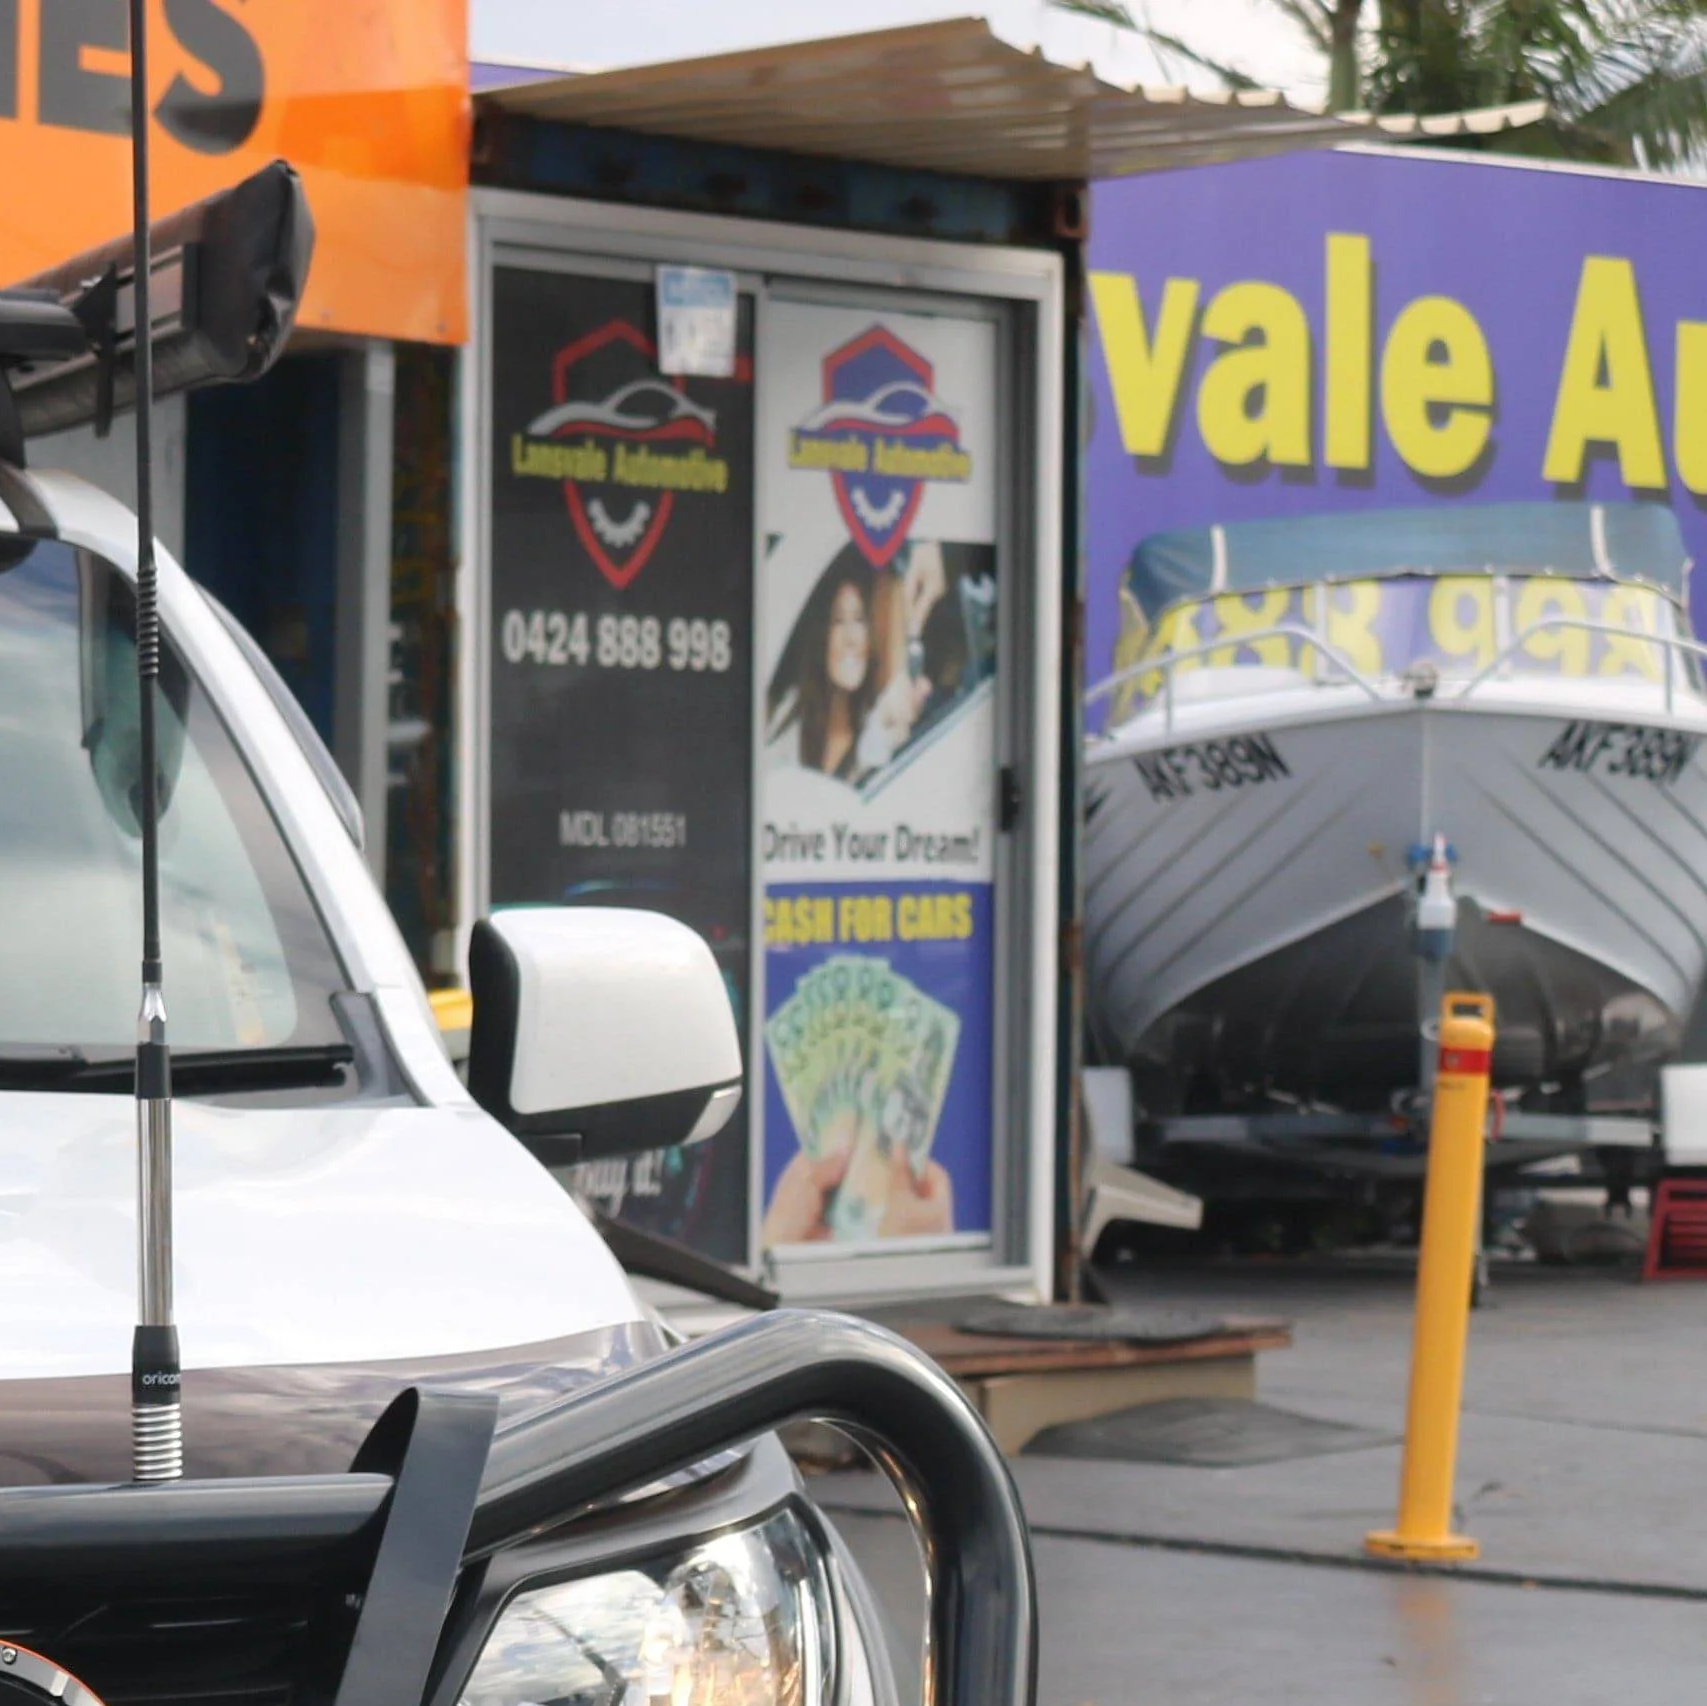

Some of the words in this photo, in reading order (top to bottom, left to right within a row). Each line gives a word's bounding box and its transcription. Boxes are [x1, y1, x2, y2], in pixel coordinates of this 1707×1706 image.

[511, 433, 607, 482] Lansvale
[612, 443, 729, 493] Automotive
[790, 428, 868, 472] Lansvale
[871, 435, 973, 484] Automotive
[502, 608, 591, 665] 0424
[596, 613, 662, 668] 888
[667, 617, 732, 671] 998
[1134, 732, 1292, 802] AKF389N
[558, 807, 610, 848] MDL
[764, 822, 826, 862] Drive
[831, 822, 889, 862] Your
[894, 823, 982, 865] Dream!
[839, 893, 893, 943] FOR
[896, 891, 973, 942] CARS
